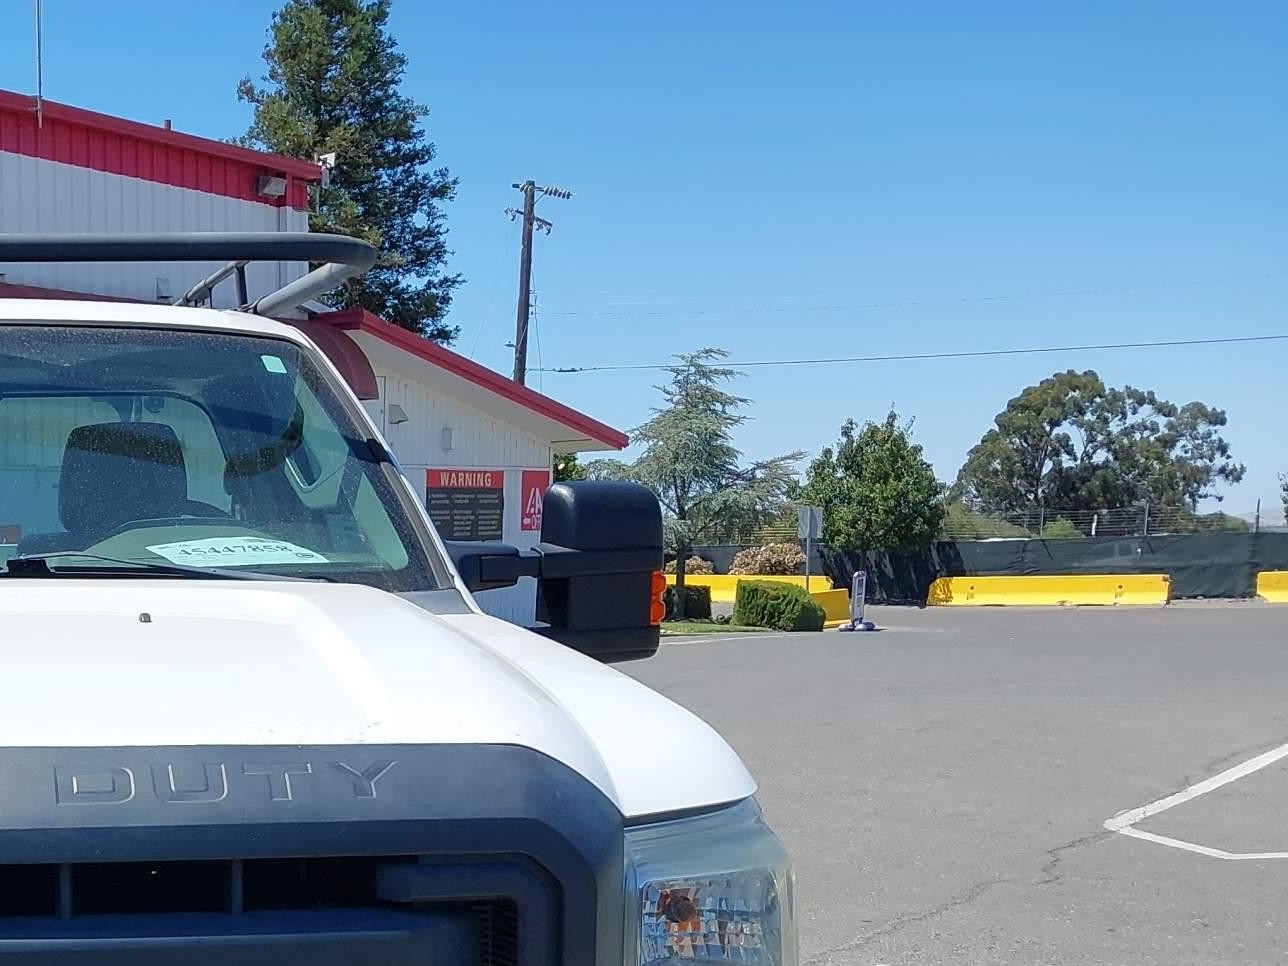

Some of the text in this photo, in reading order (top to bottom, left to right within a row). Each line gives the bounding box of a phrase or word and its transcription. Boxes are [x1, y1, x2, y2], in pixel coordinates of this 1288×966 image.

[440, 472, 492, 487] WARNING
[178, 544, 293, 556] 45447858
[53, 759, 399, 806] DUTY
